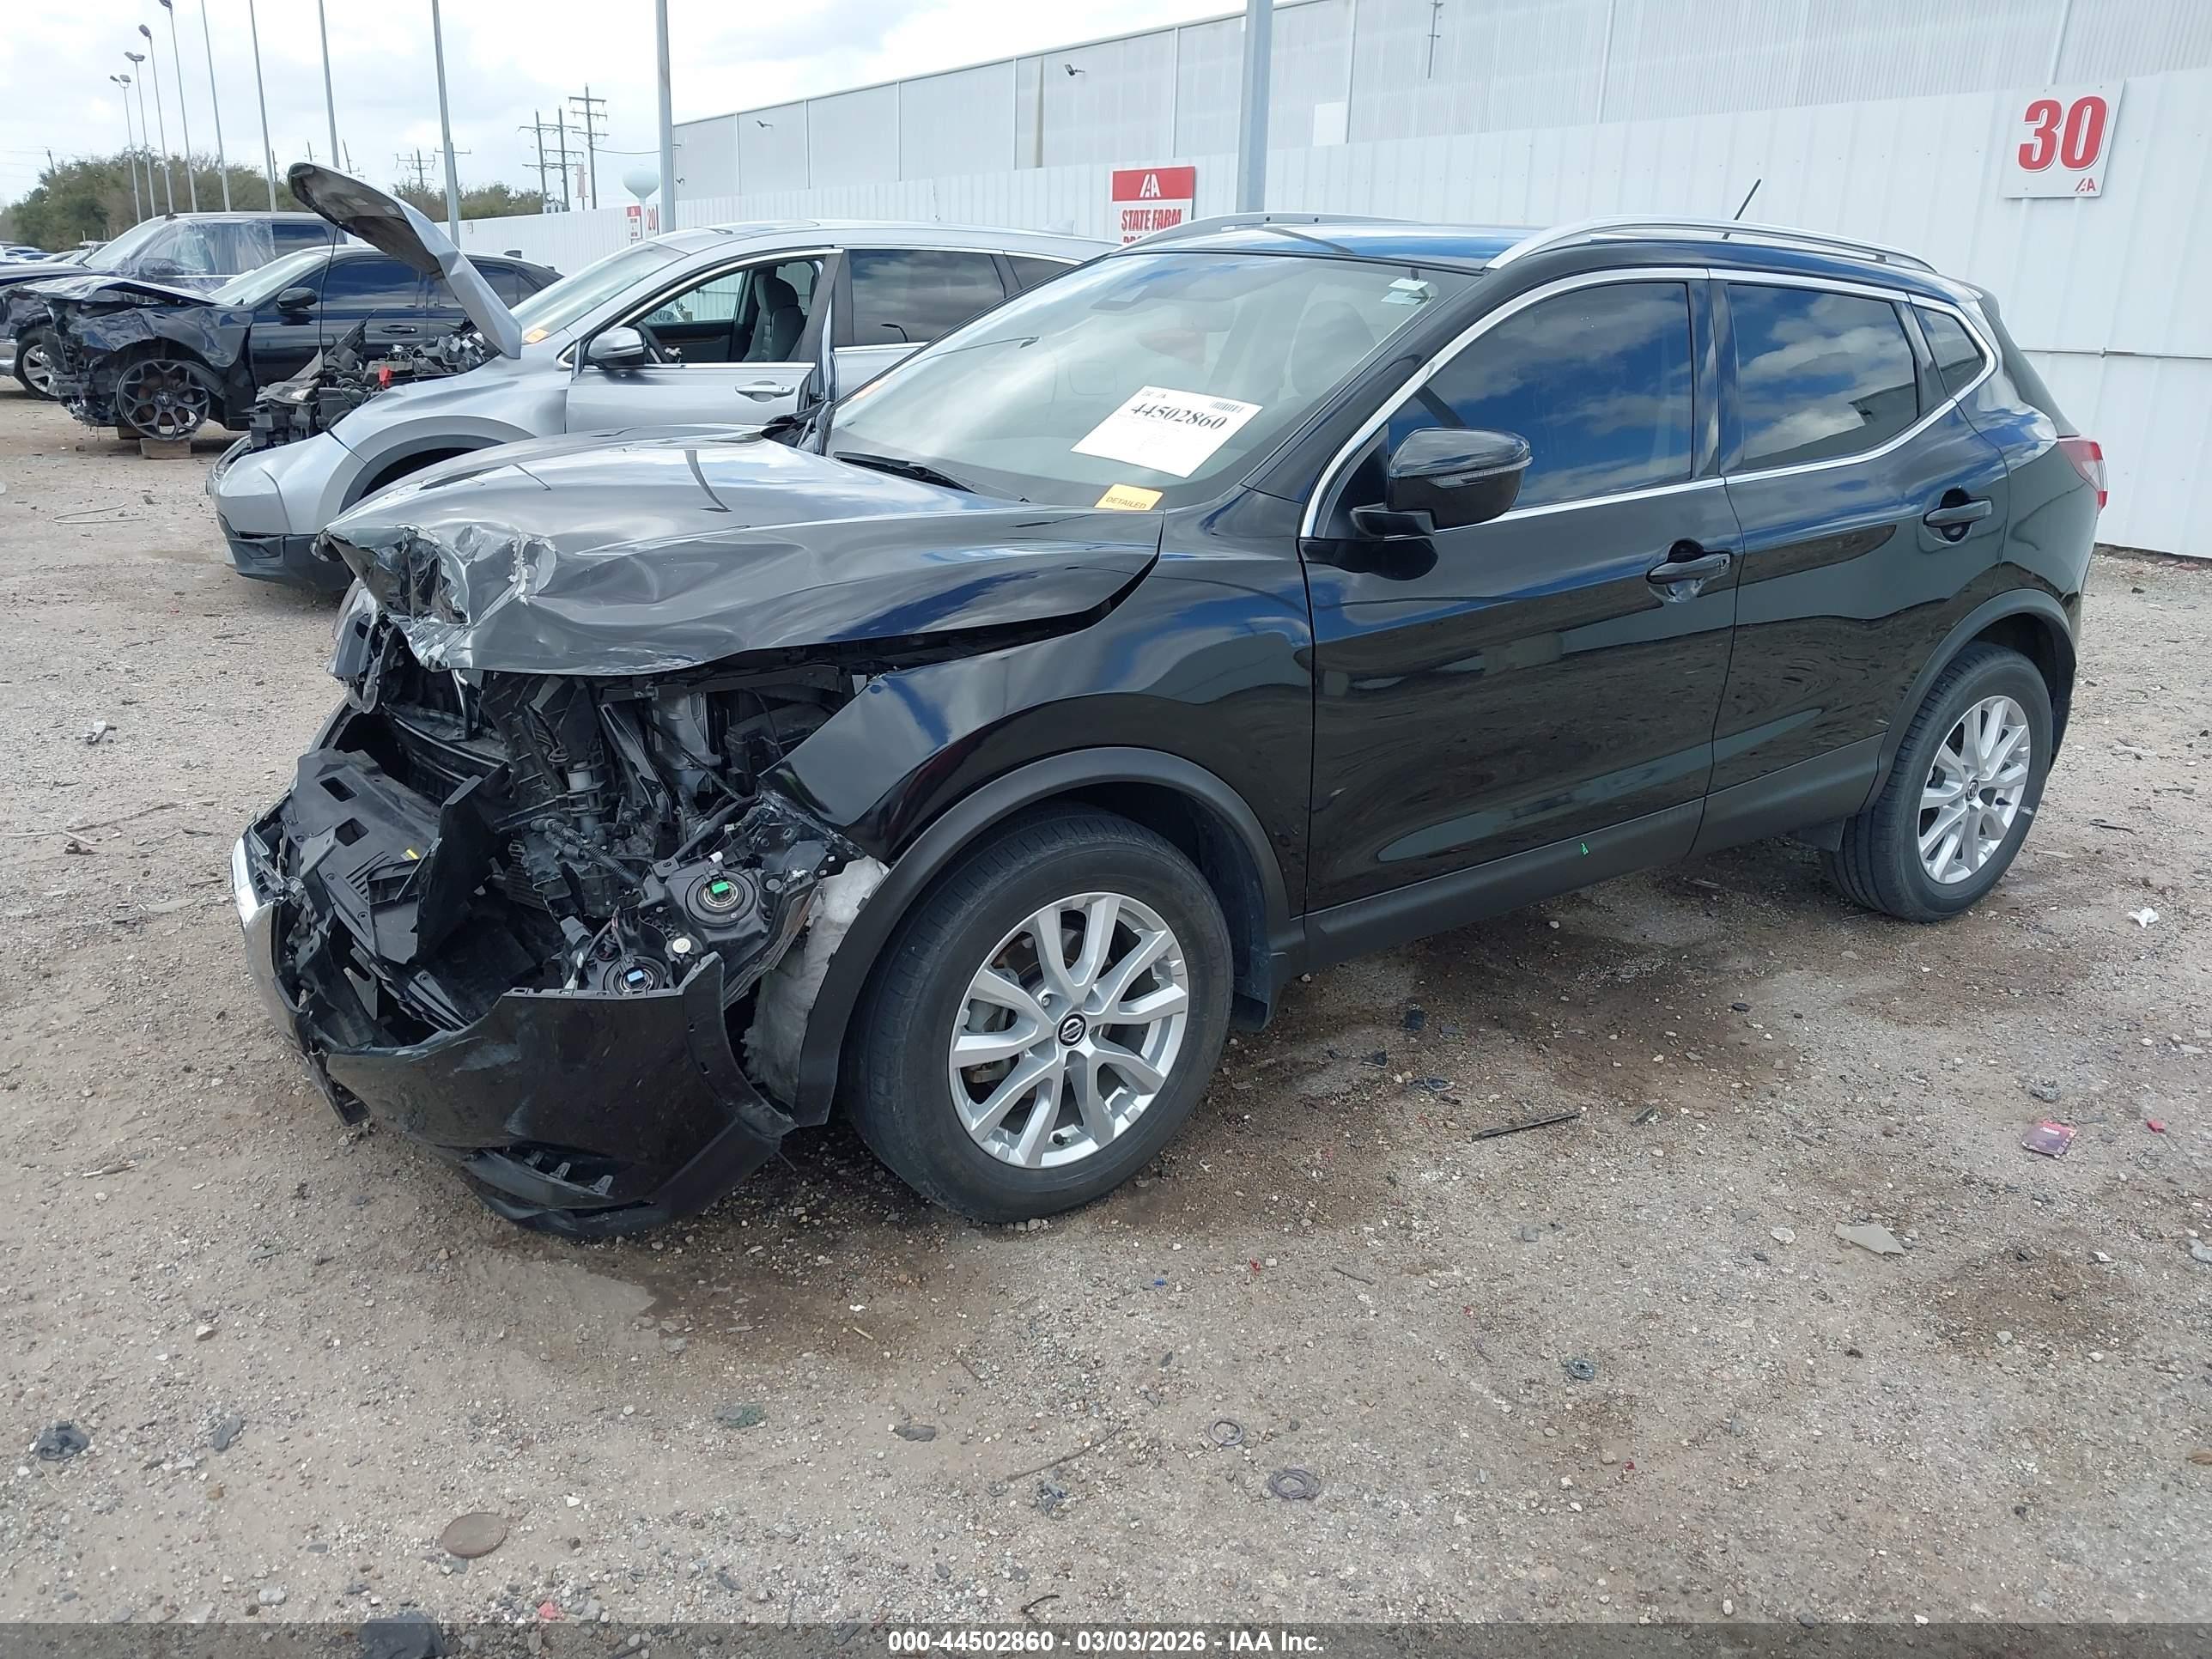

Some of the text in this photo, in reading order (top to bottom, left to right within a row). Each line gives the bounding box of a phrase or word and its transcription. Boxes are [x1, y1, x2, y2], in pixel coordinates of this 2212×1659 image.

[2018, 95, 2108, 172] 30
[1121, 208, 1182, 232] STATE FARM
[1130, 402, 1228, 430] 44502860
[1105, 495, 1147, 510] DETAILED
